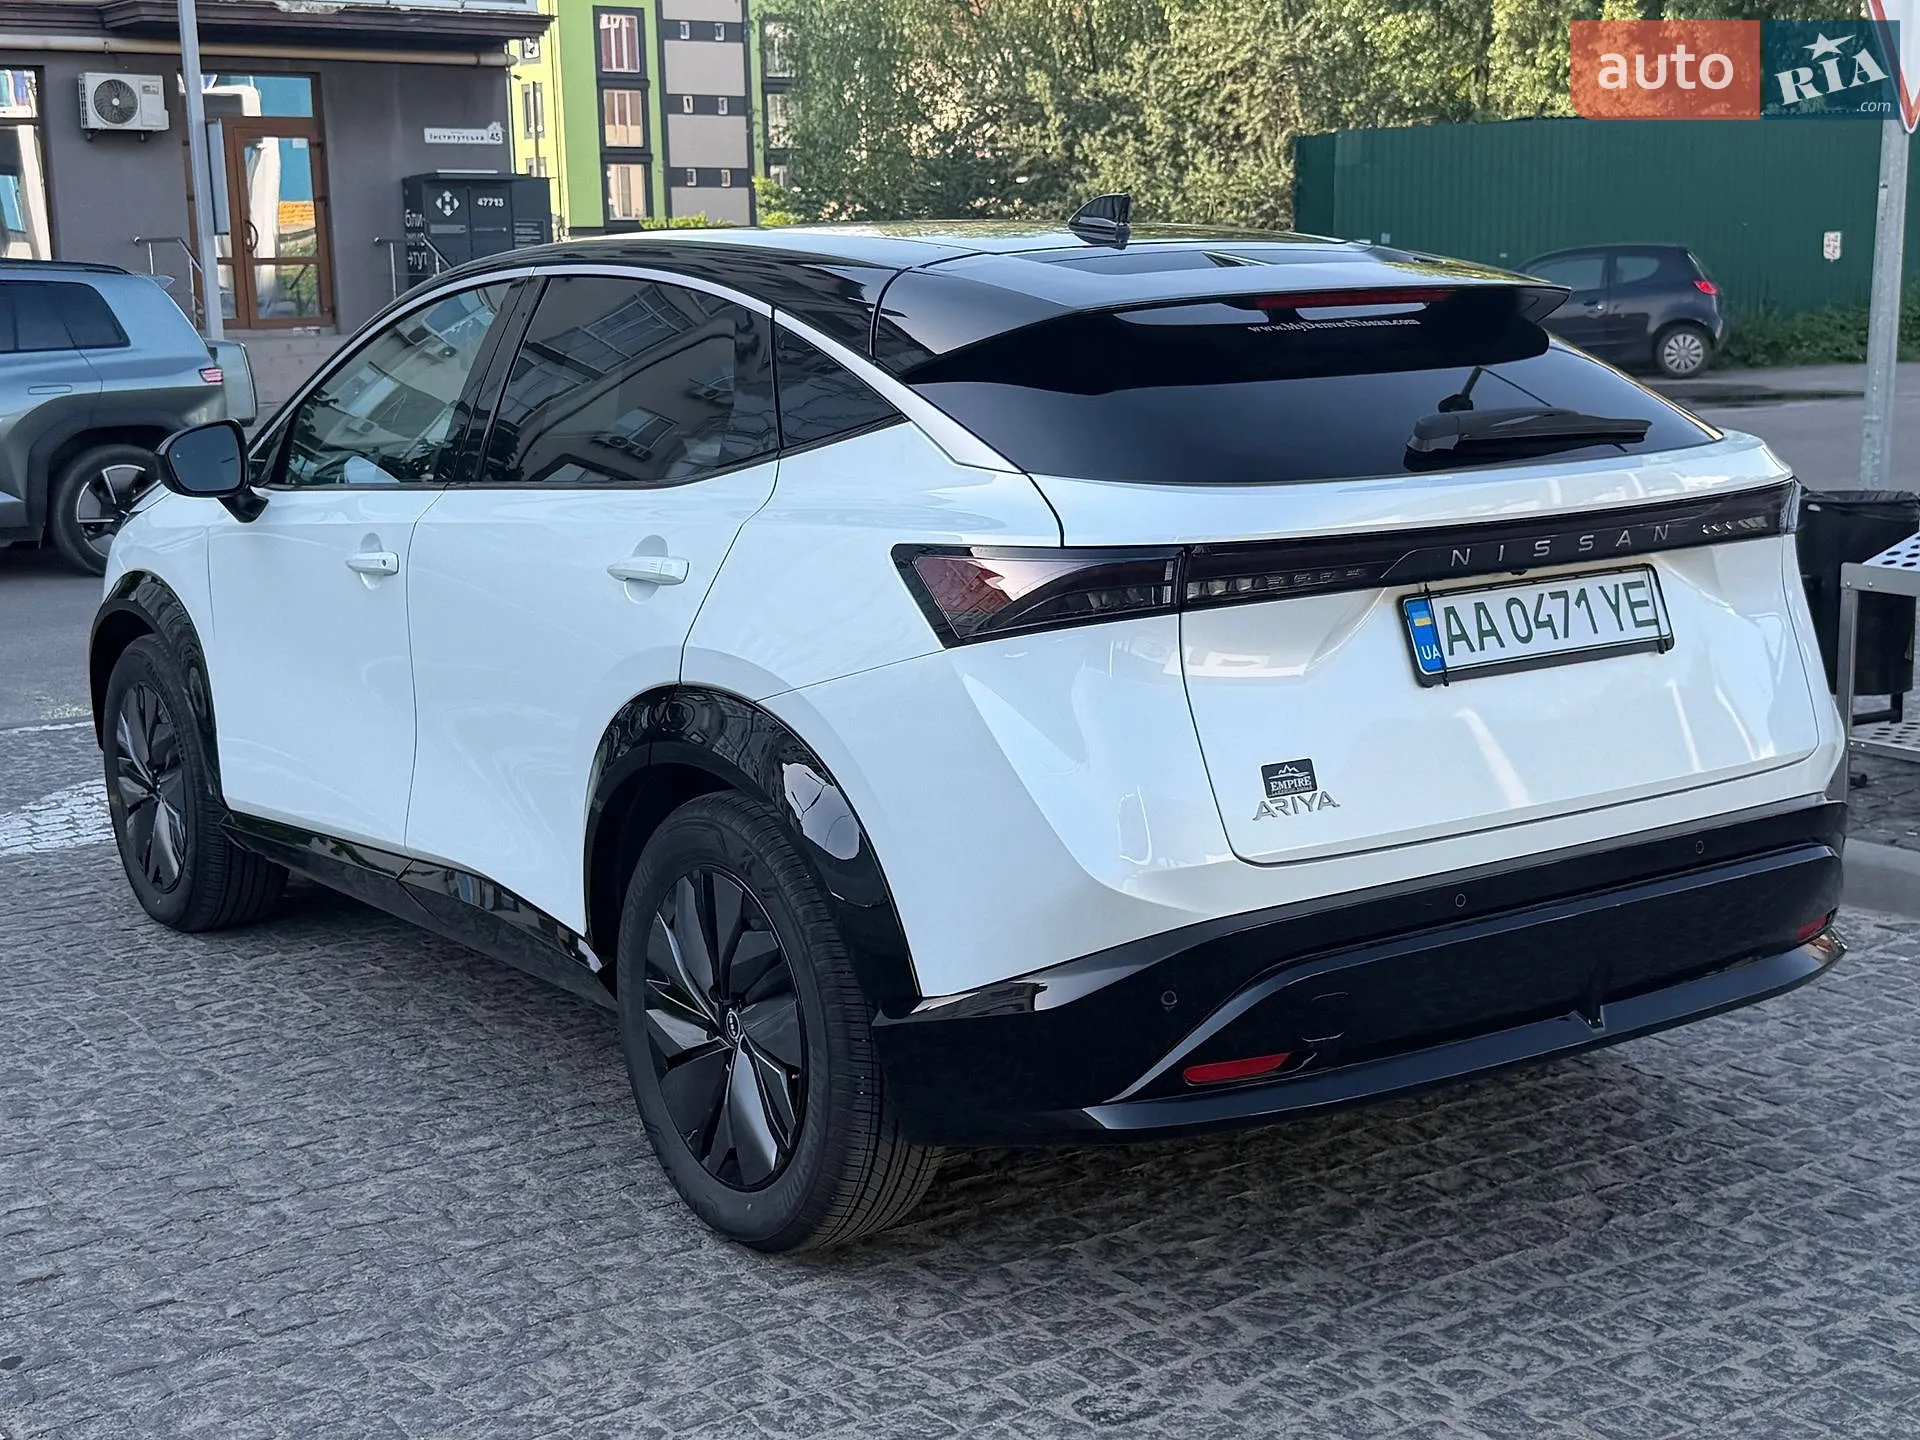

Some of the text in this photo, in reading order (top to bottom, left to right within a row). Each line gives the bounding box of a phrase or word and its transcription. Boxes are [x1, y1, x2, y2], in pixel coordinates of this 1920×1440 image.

[489, 132, 501, 142] 45
[1450, 524, 1669, 568] NISSAN
[1421, 643, 1442, 661] UA
[1269, 775, 1313, 792] EMPIRE
[1252, 790, 1341, 821] ARIYA
